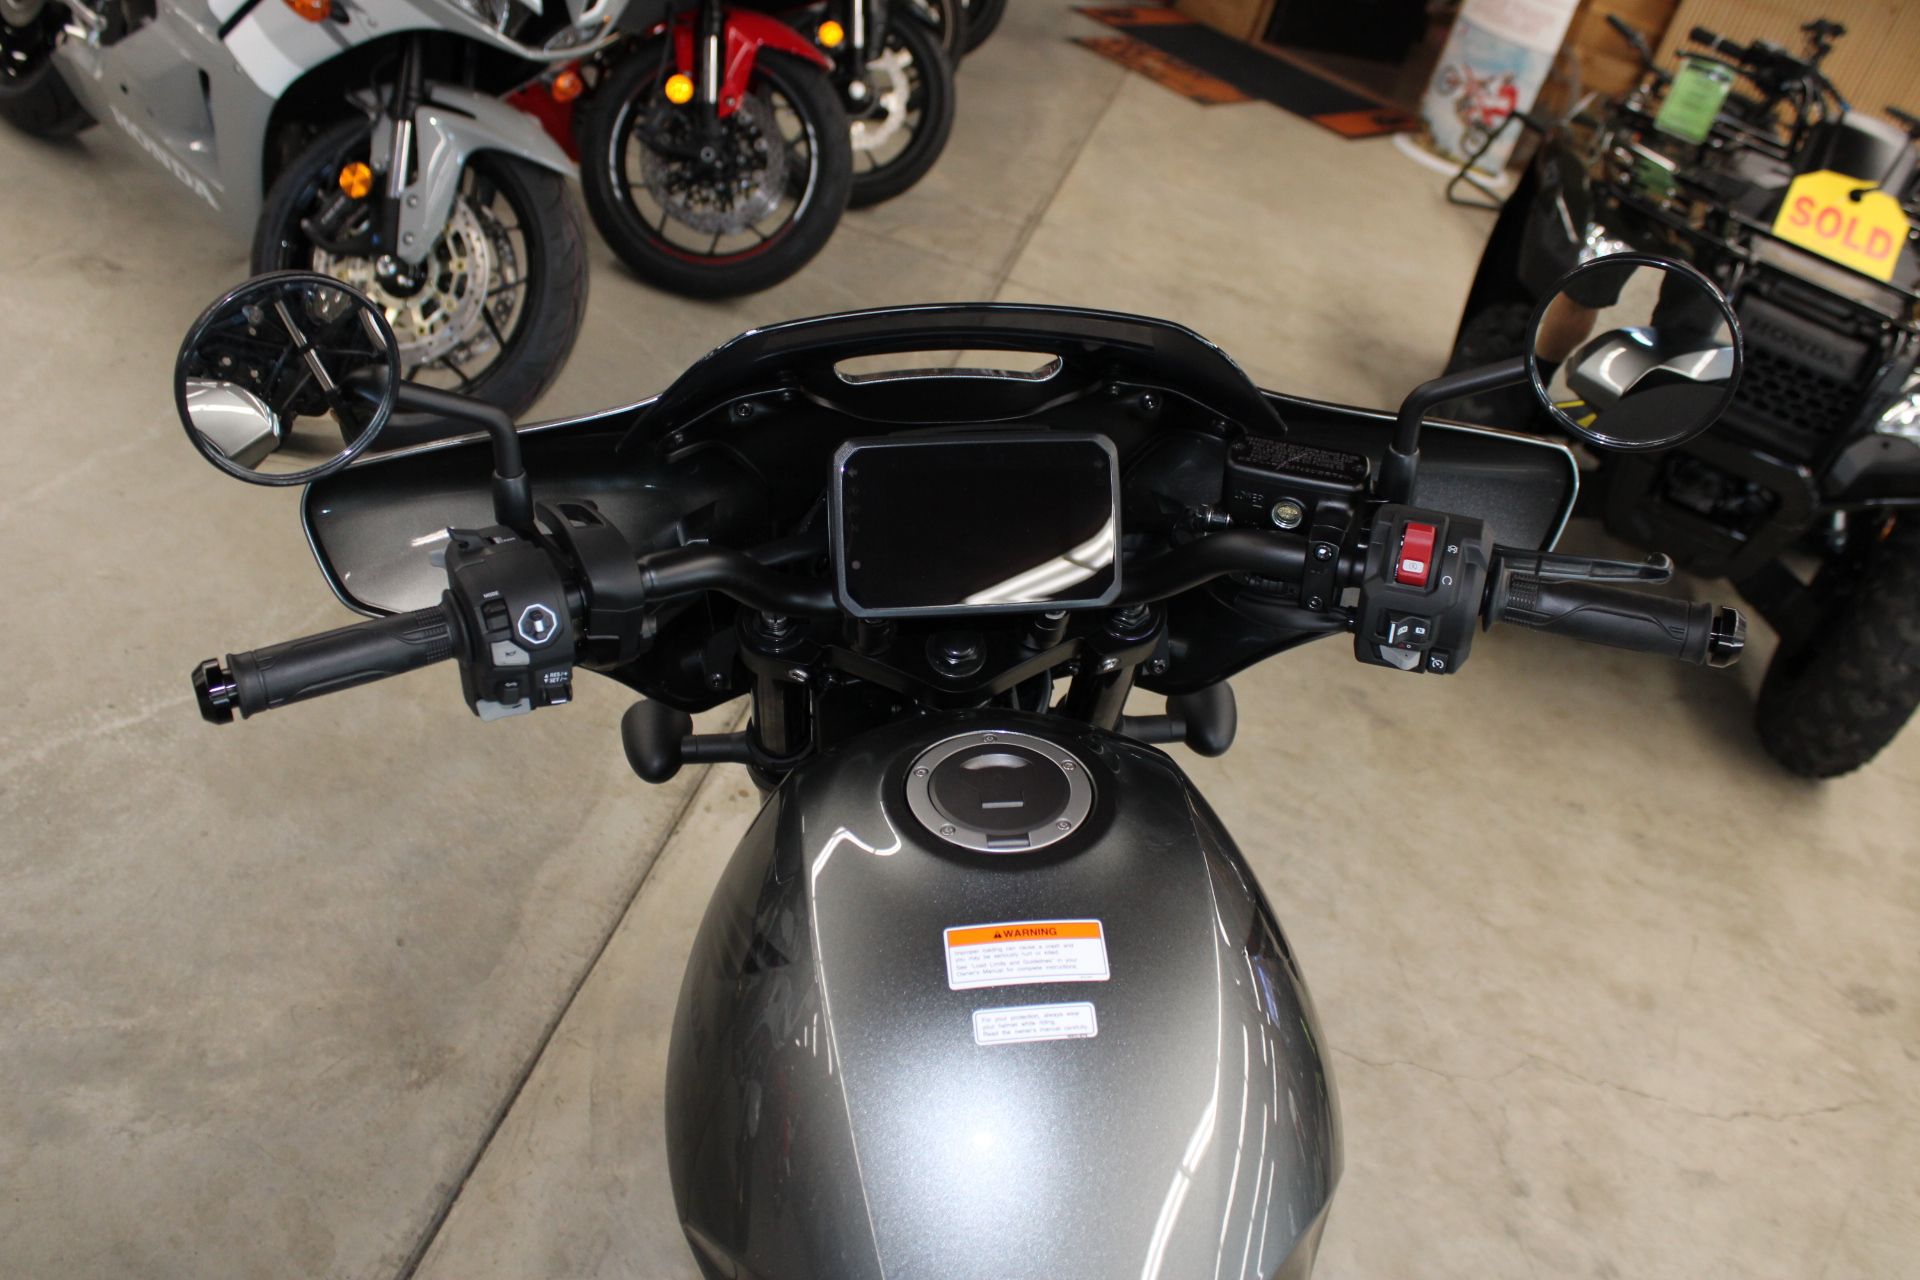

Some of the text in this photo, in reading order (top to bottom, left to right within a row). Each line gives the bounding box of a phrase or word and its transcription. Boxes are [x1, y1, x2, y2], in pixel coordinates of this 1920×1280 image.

[1788, 197, 1893, 261] SOLD
[1748, 316, 1846, 370] HONDA
[1003, 928, 1057, 938] WARNING
